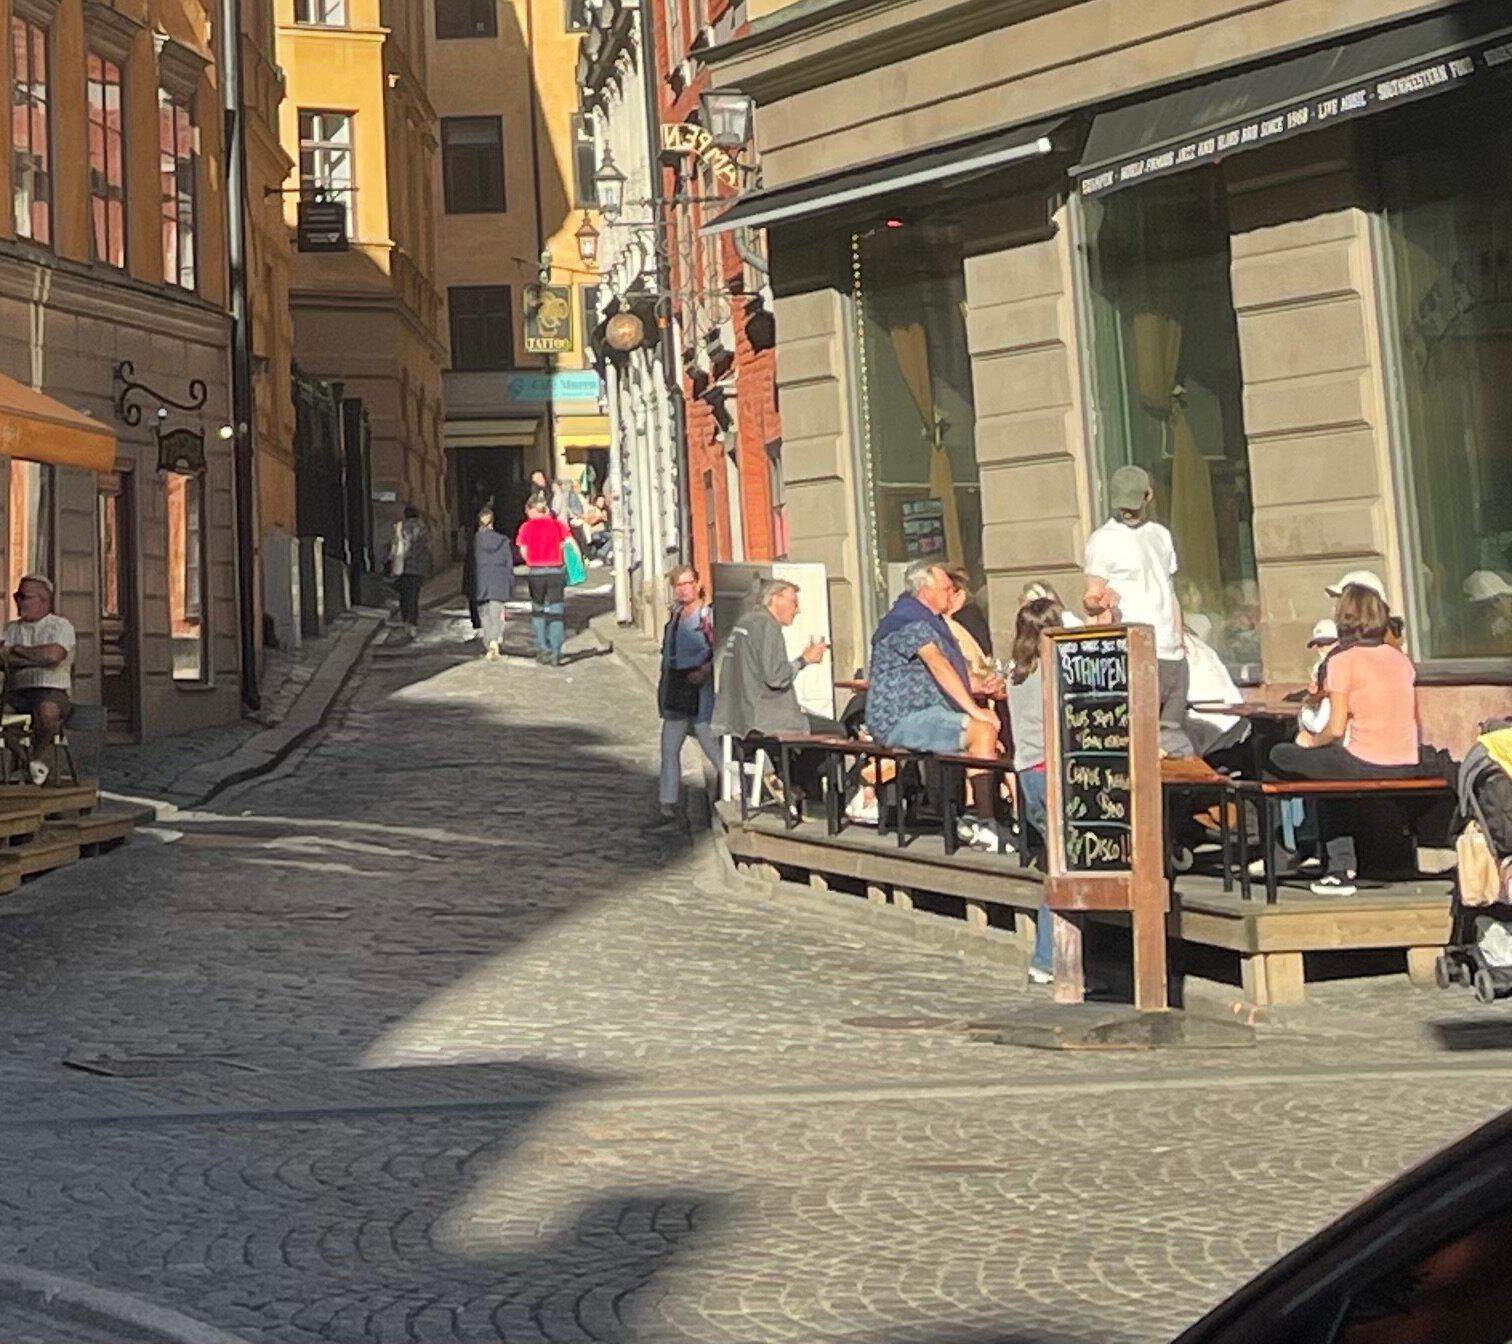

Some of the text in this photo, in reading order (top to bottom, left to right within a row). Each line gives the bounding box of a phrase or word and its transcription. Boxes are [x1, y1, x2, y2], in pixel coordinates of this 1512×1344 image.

[1260, 115, 1284, 138] SINCE
[1317, 98, 1338, 120] LIVE
[1061, 654, 1127, 690] STAMPEN
